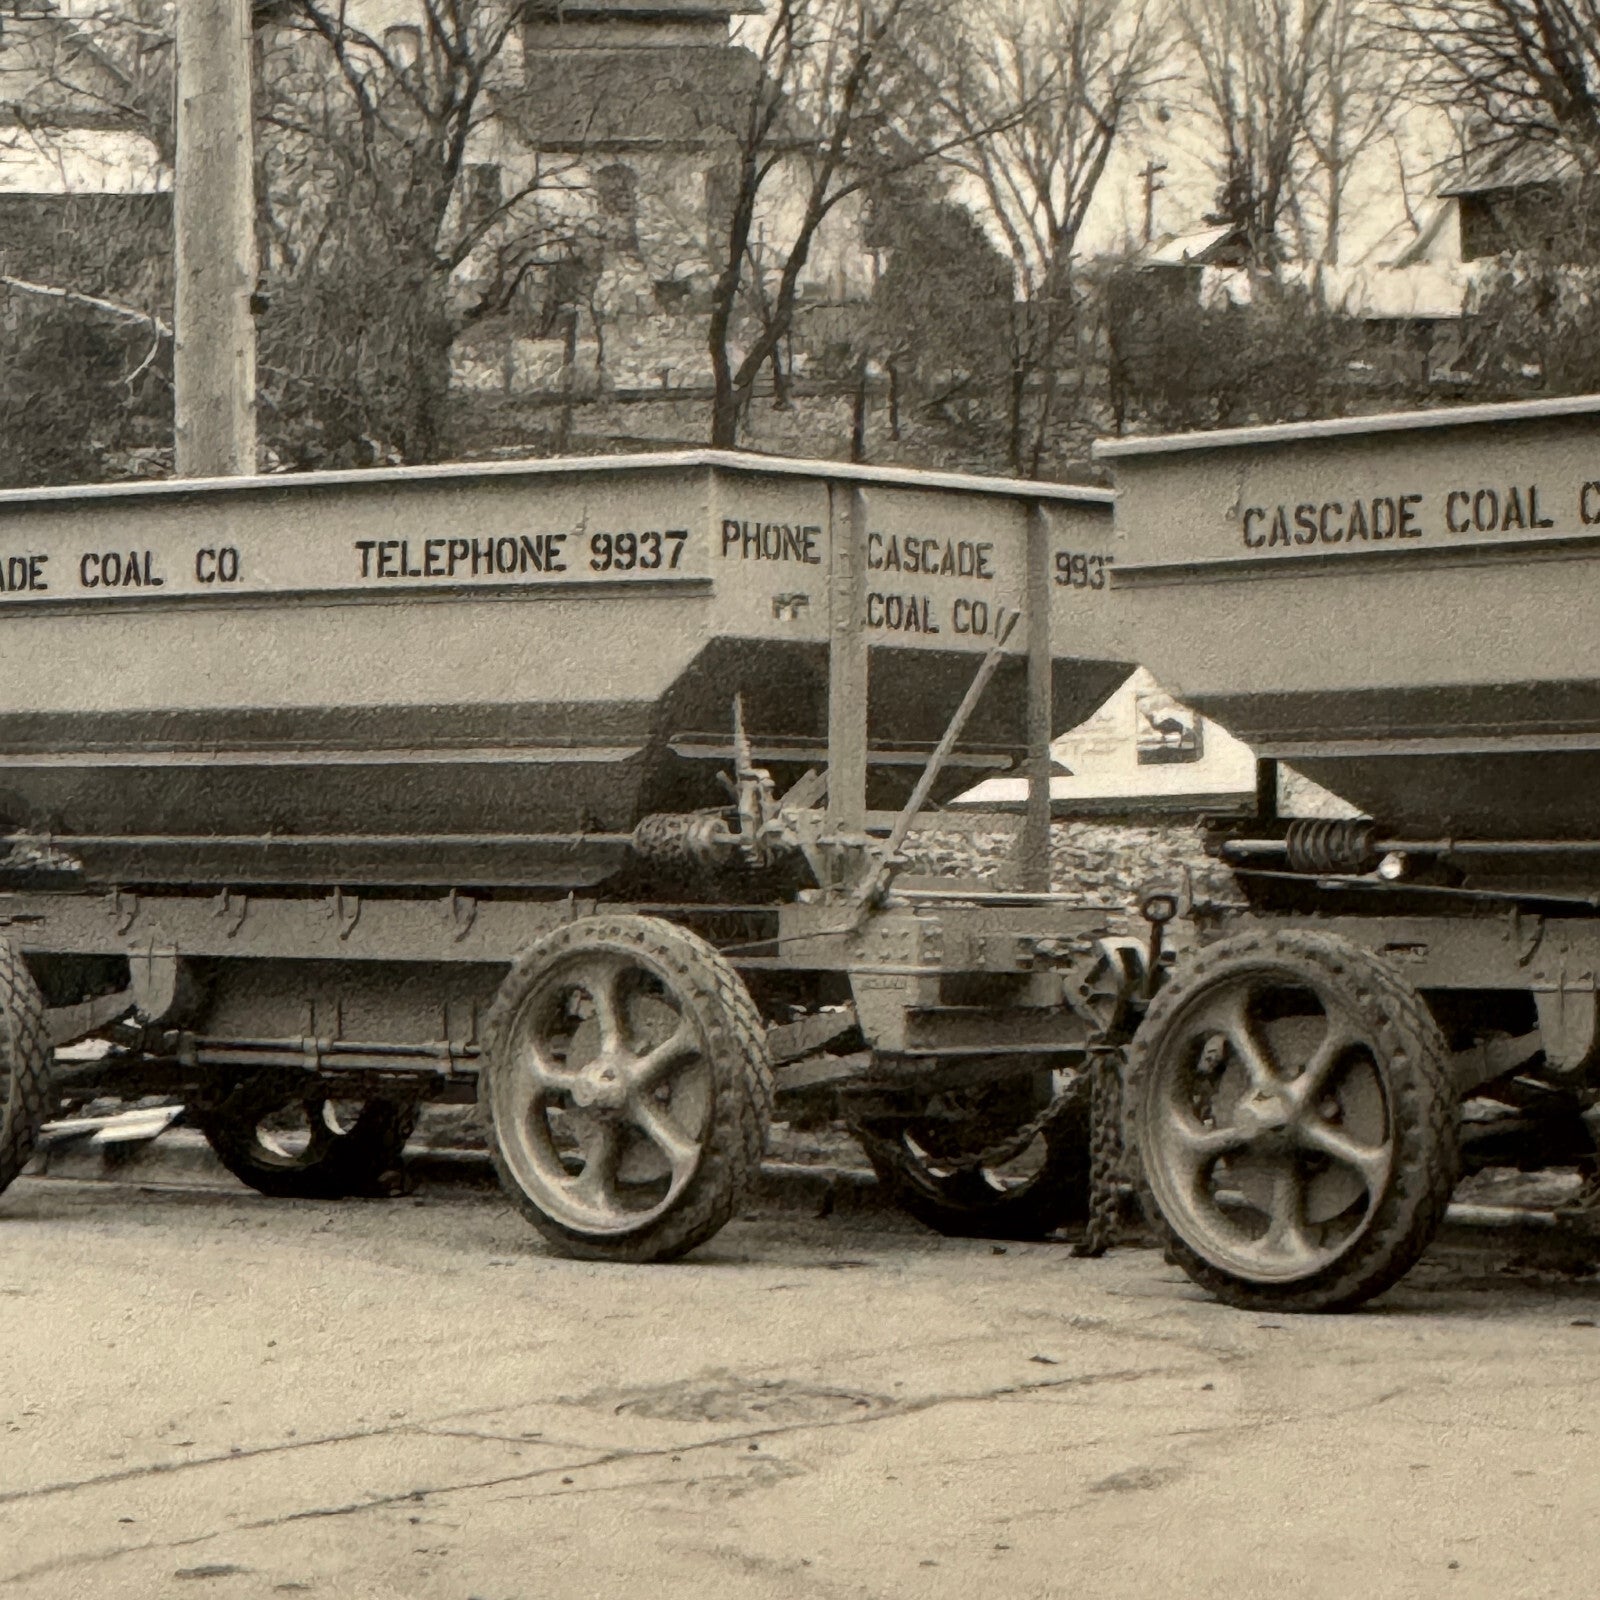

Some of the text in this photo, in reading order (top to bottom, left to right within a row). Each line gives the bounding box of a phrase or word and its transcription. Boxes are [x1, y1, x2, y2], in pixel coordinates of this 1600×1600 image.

[1243, 494, 1422, 549] CASCADE
[1446, 483, 1554, 532] COAL
[0, 530, 688, 592] DE COAL CO. TELEPHONE 9937
[721, 519, 822, 564] PHONE
[867, 532, 994, 578] CASCADE
[1055, 551, 1114, 590] 993
[866, 591, 940, 634] COAL
